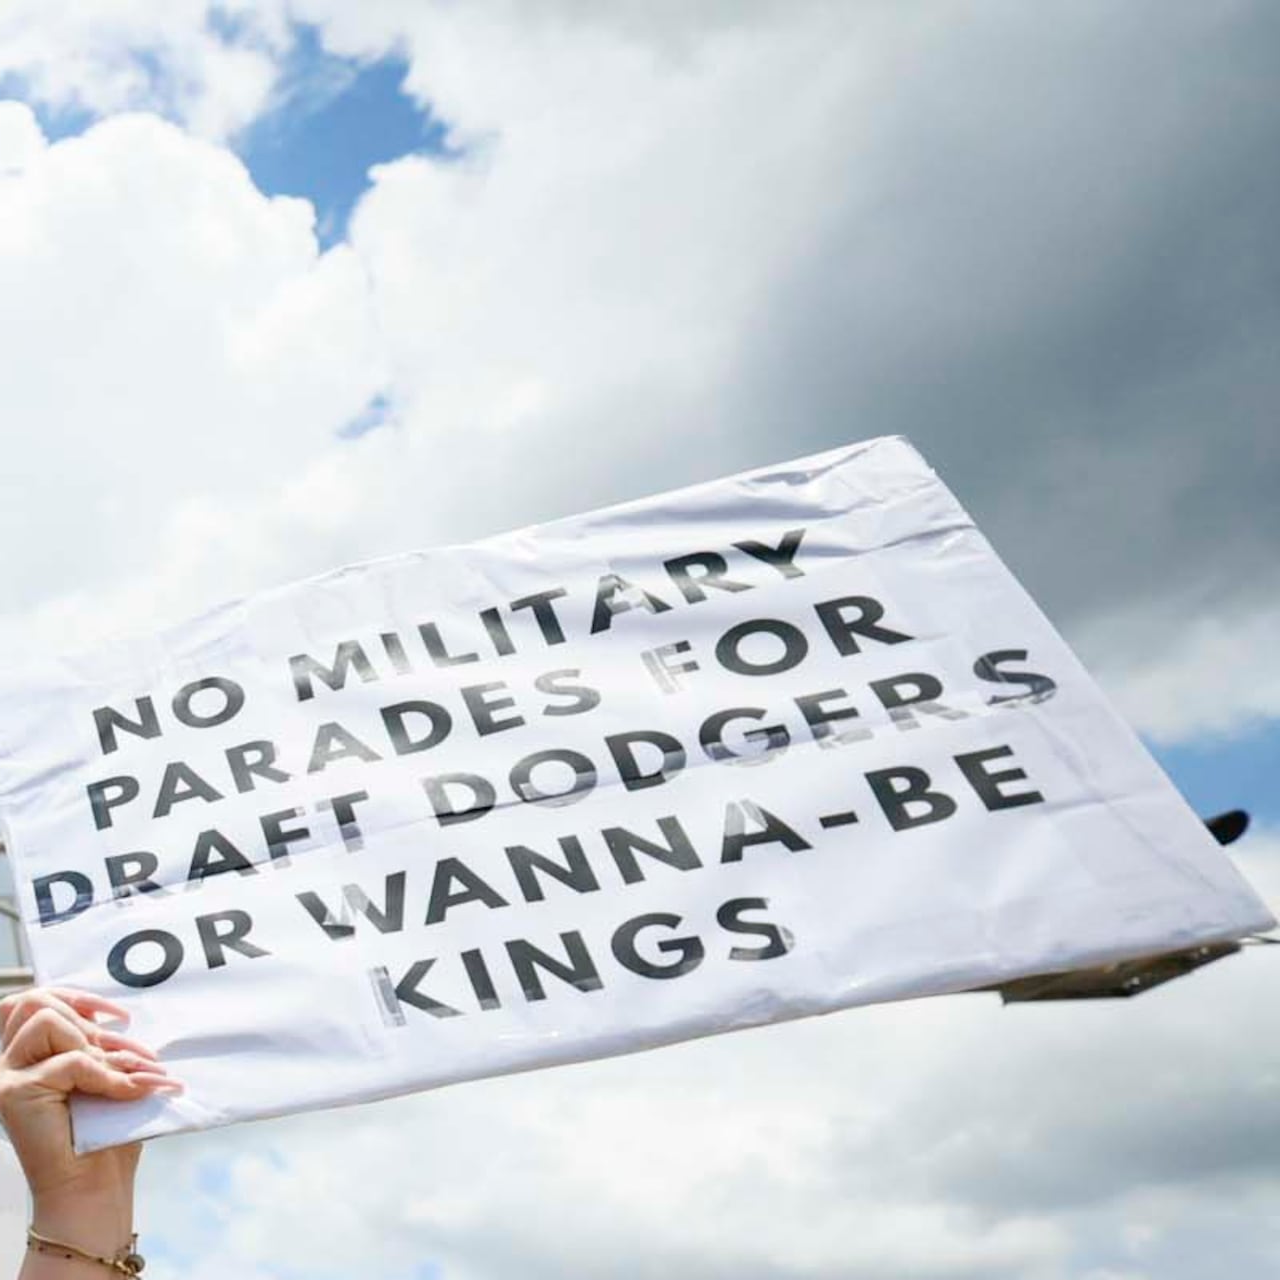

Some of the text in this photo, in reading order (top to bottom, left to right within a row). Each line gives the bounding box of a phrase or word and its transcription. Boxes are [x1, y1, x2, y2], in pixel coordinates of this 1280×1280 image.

[88, 595, 911, 831] PARADES FOR
[92, 529, 808, 753] NO MILITARY
[32, 647, 1059, 930] DRAFT DODGERS
[106, 744, 1047, 990] OR WANNA-BE
[370, 896, 796, 1029] KINGS
